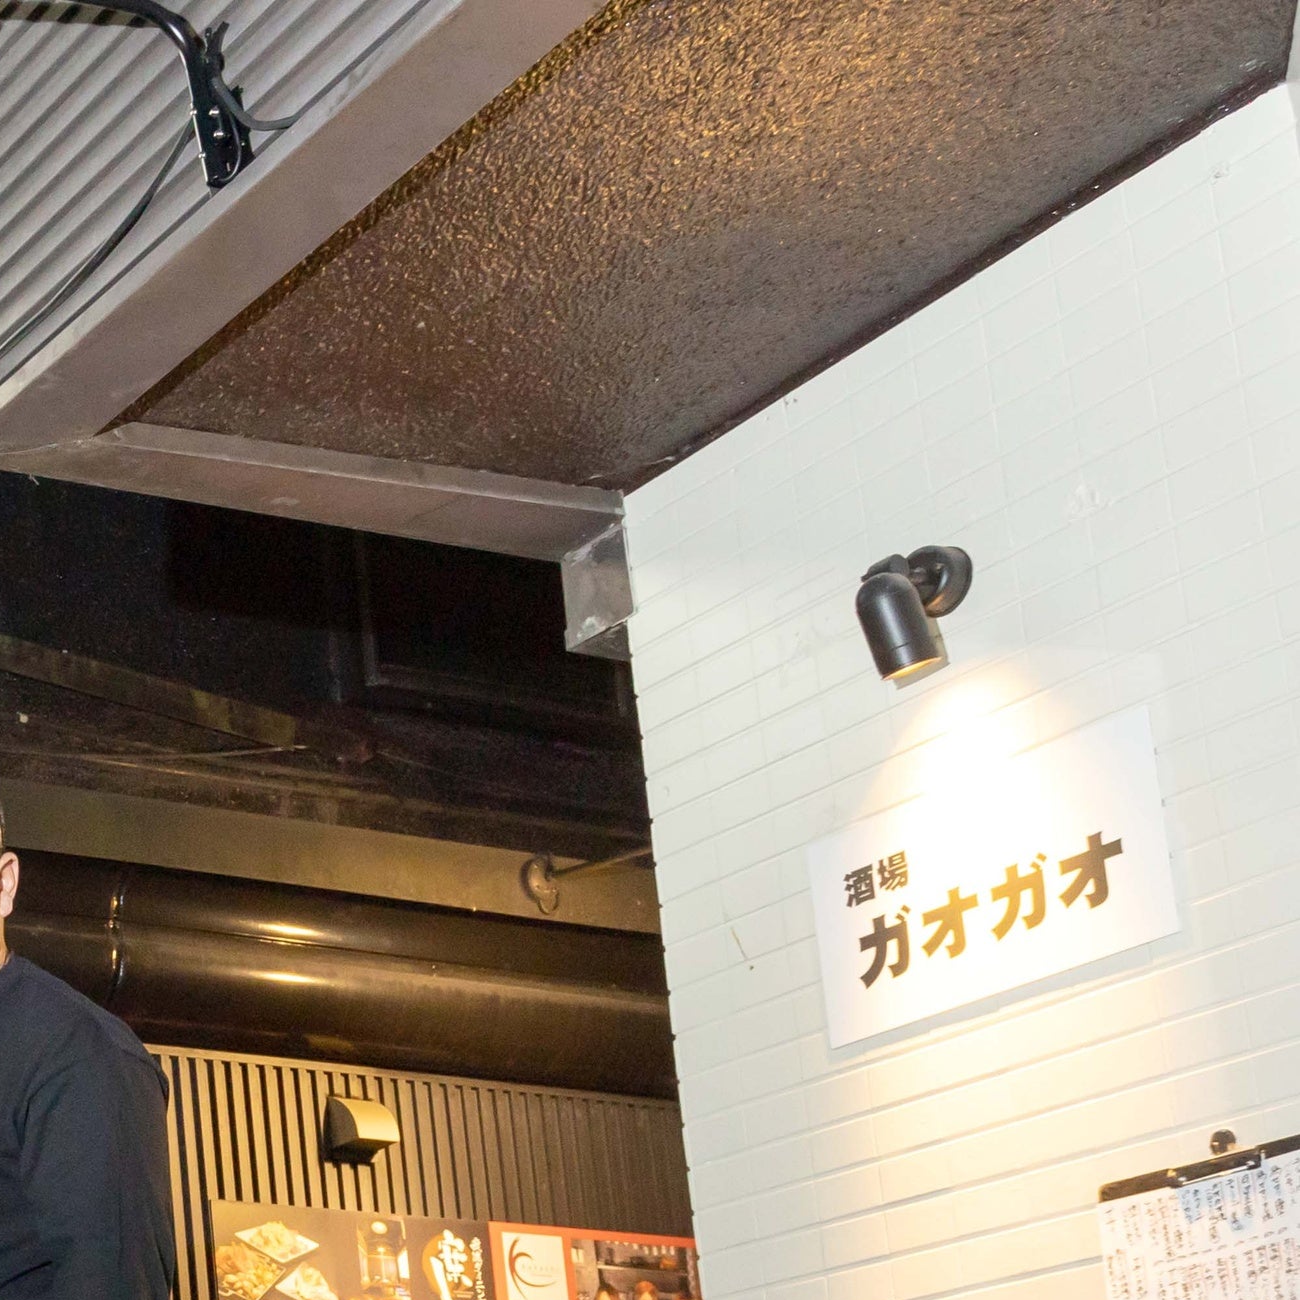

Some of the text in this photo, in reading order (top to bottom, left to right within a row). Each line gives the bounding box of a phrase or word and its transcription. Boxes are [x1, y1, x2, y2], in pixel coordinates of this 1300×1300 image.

[843, 850, 910, 908] 酒場
[858, 830, 1124, 989] ガオガオ
